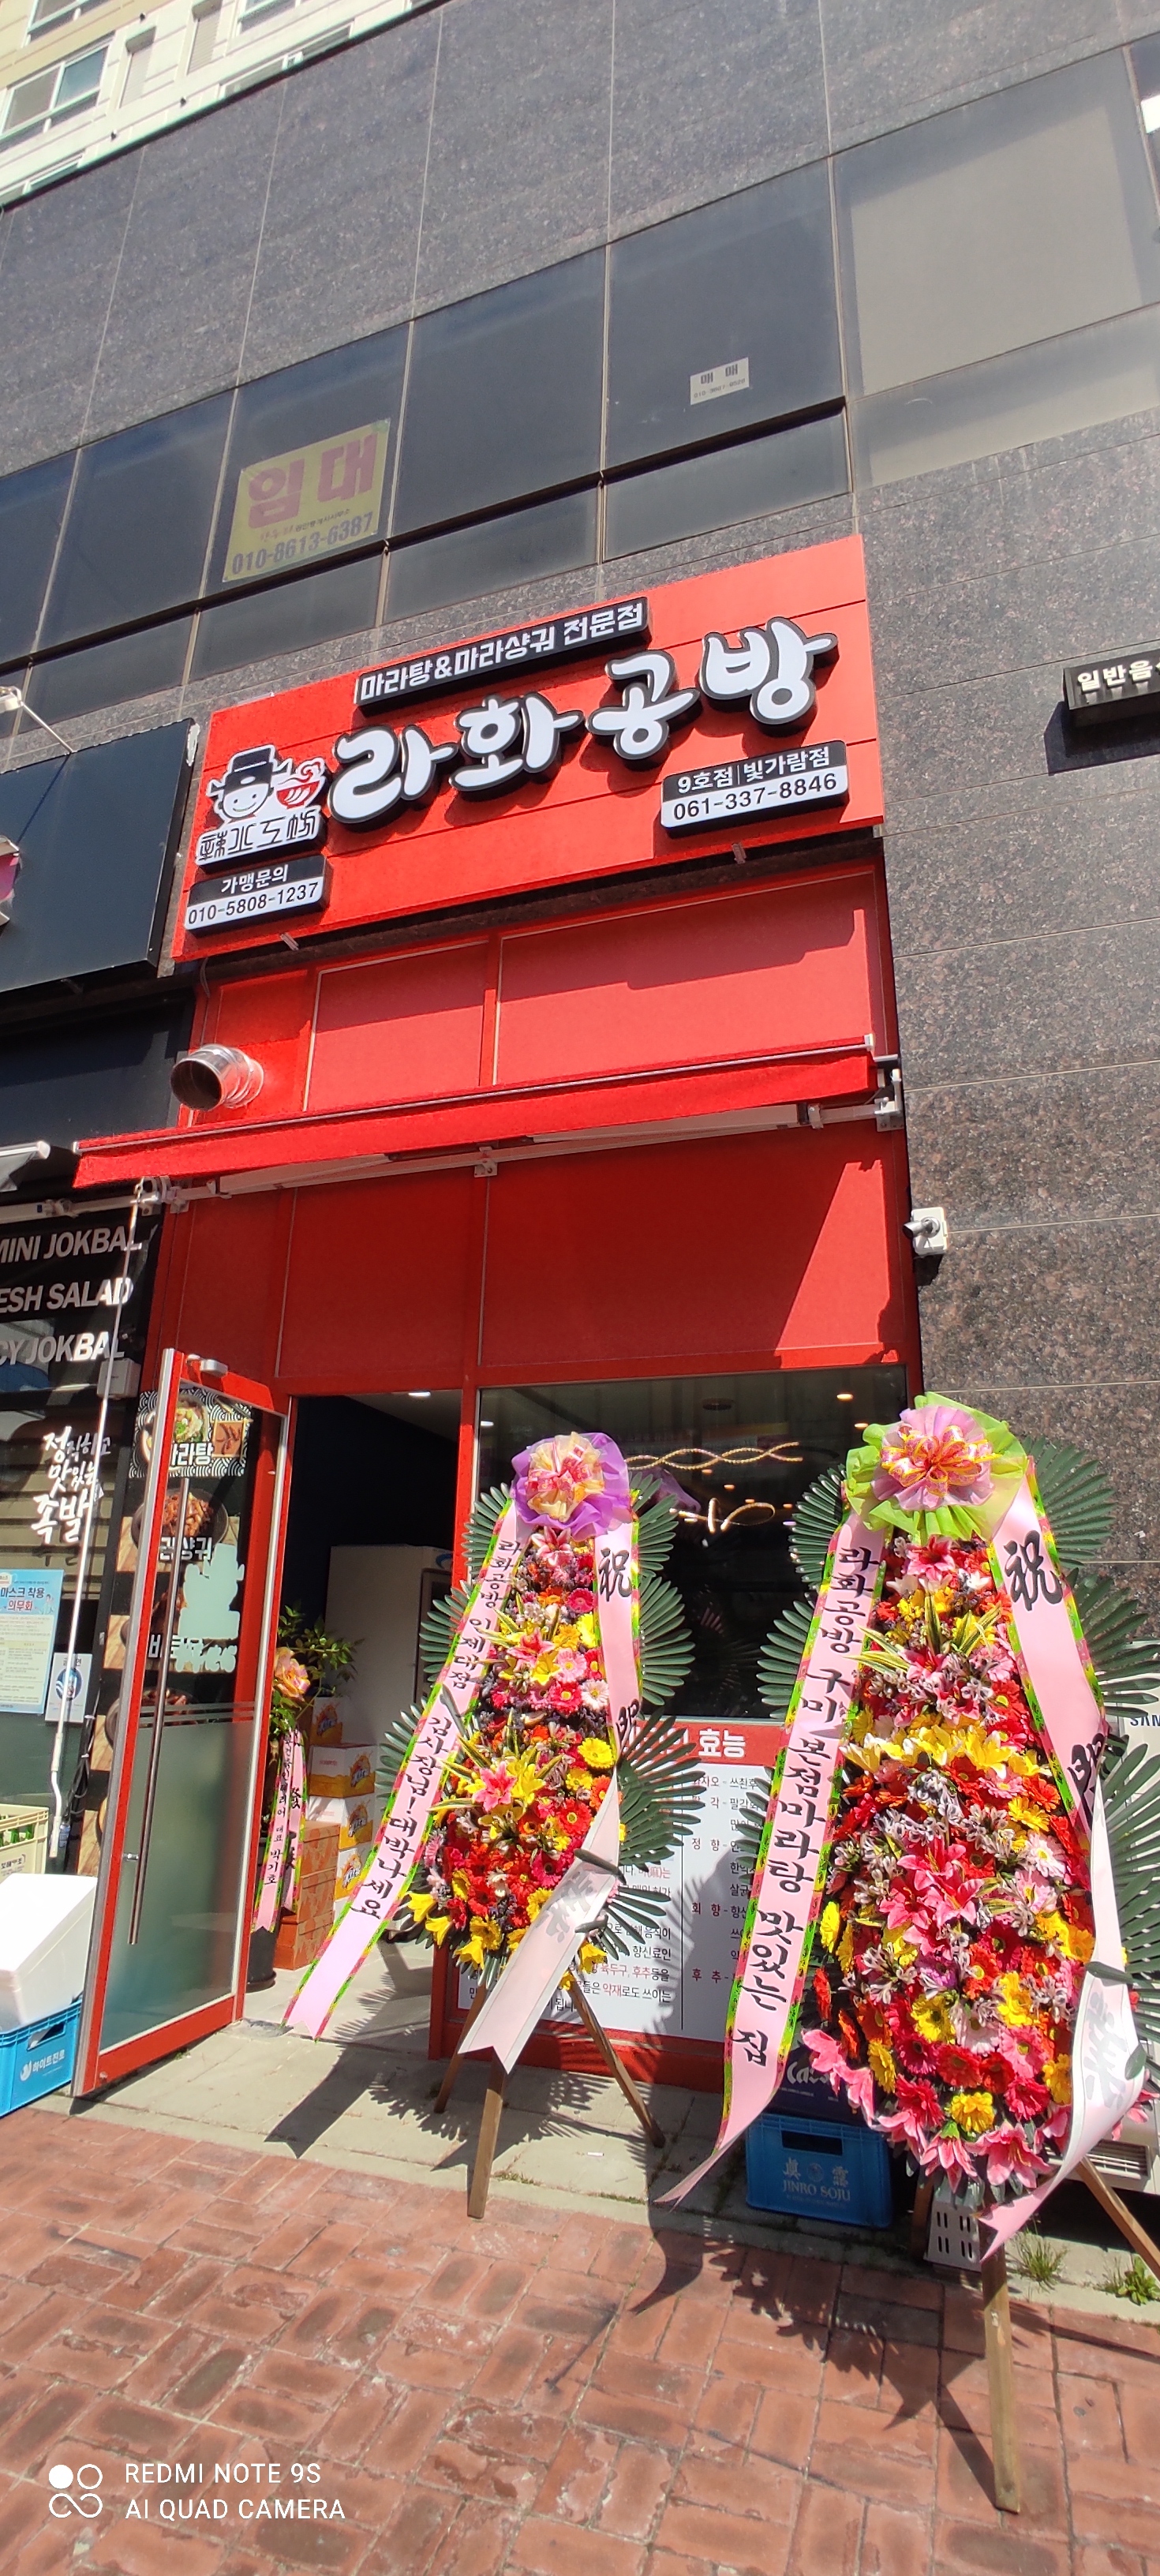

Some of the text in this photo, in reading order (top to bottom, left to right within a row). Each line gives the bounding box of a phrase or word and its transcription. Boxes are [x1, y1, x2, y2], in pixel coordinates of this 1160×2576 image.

[248, 433, 378, 530] 임대
[232, 511, 373, 575] 010-8613-6387
[563, 601, 643, 646] 전문점
[1077, 660, 1160, 691] 일반음
[330, 620, 836, 822] 라화공방
[673, 773, 837, 820] 061-337-8846
[221, 863, 289, 894] 가맹문의
[188, 882, 319, 925] 010-5808-1237
[43, 1225, 142, 1260] JOKBAL
[47, 1277, 134, 1310] SALAD
[25, 1331, 125, 1365] JOKBAL
[43, 1425, 111, 1463] 정직하고
[48, 1458, 99, 1498] 맛있는
[31, 1488, 92, 1544] 족발
[481, 1540, 522, 1609] 라화공방
[598, 1547, 632, 1602] 祝
[1004, 1530, 1062, 1611] 祝
[0, 1586, 45, 1599] 마스크 착용
[819, 1546, 881, 1653] 라화공방
[800, 1668, 851, 1724] 구미
[698, 1728, 746, 1758] 효능
[633, 1945, 671, 1961] 향신료인
[739, 1909, 805, 2012] 맛있는
[642, 1987, 671, 2004] 쓰이는
[32, 2049, 65, 2072] 하이트진로
[732, 2028, 769, 2067] 집
[783, 2179, 818, 2196] JINRO
[820, 2185, 851, 2202] SOJU
